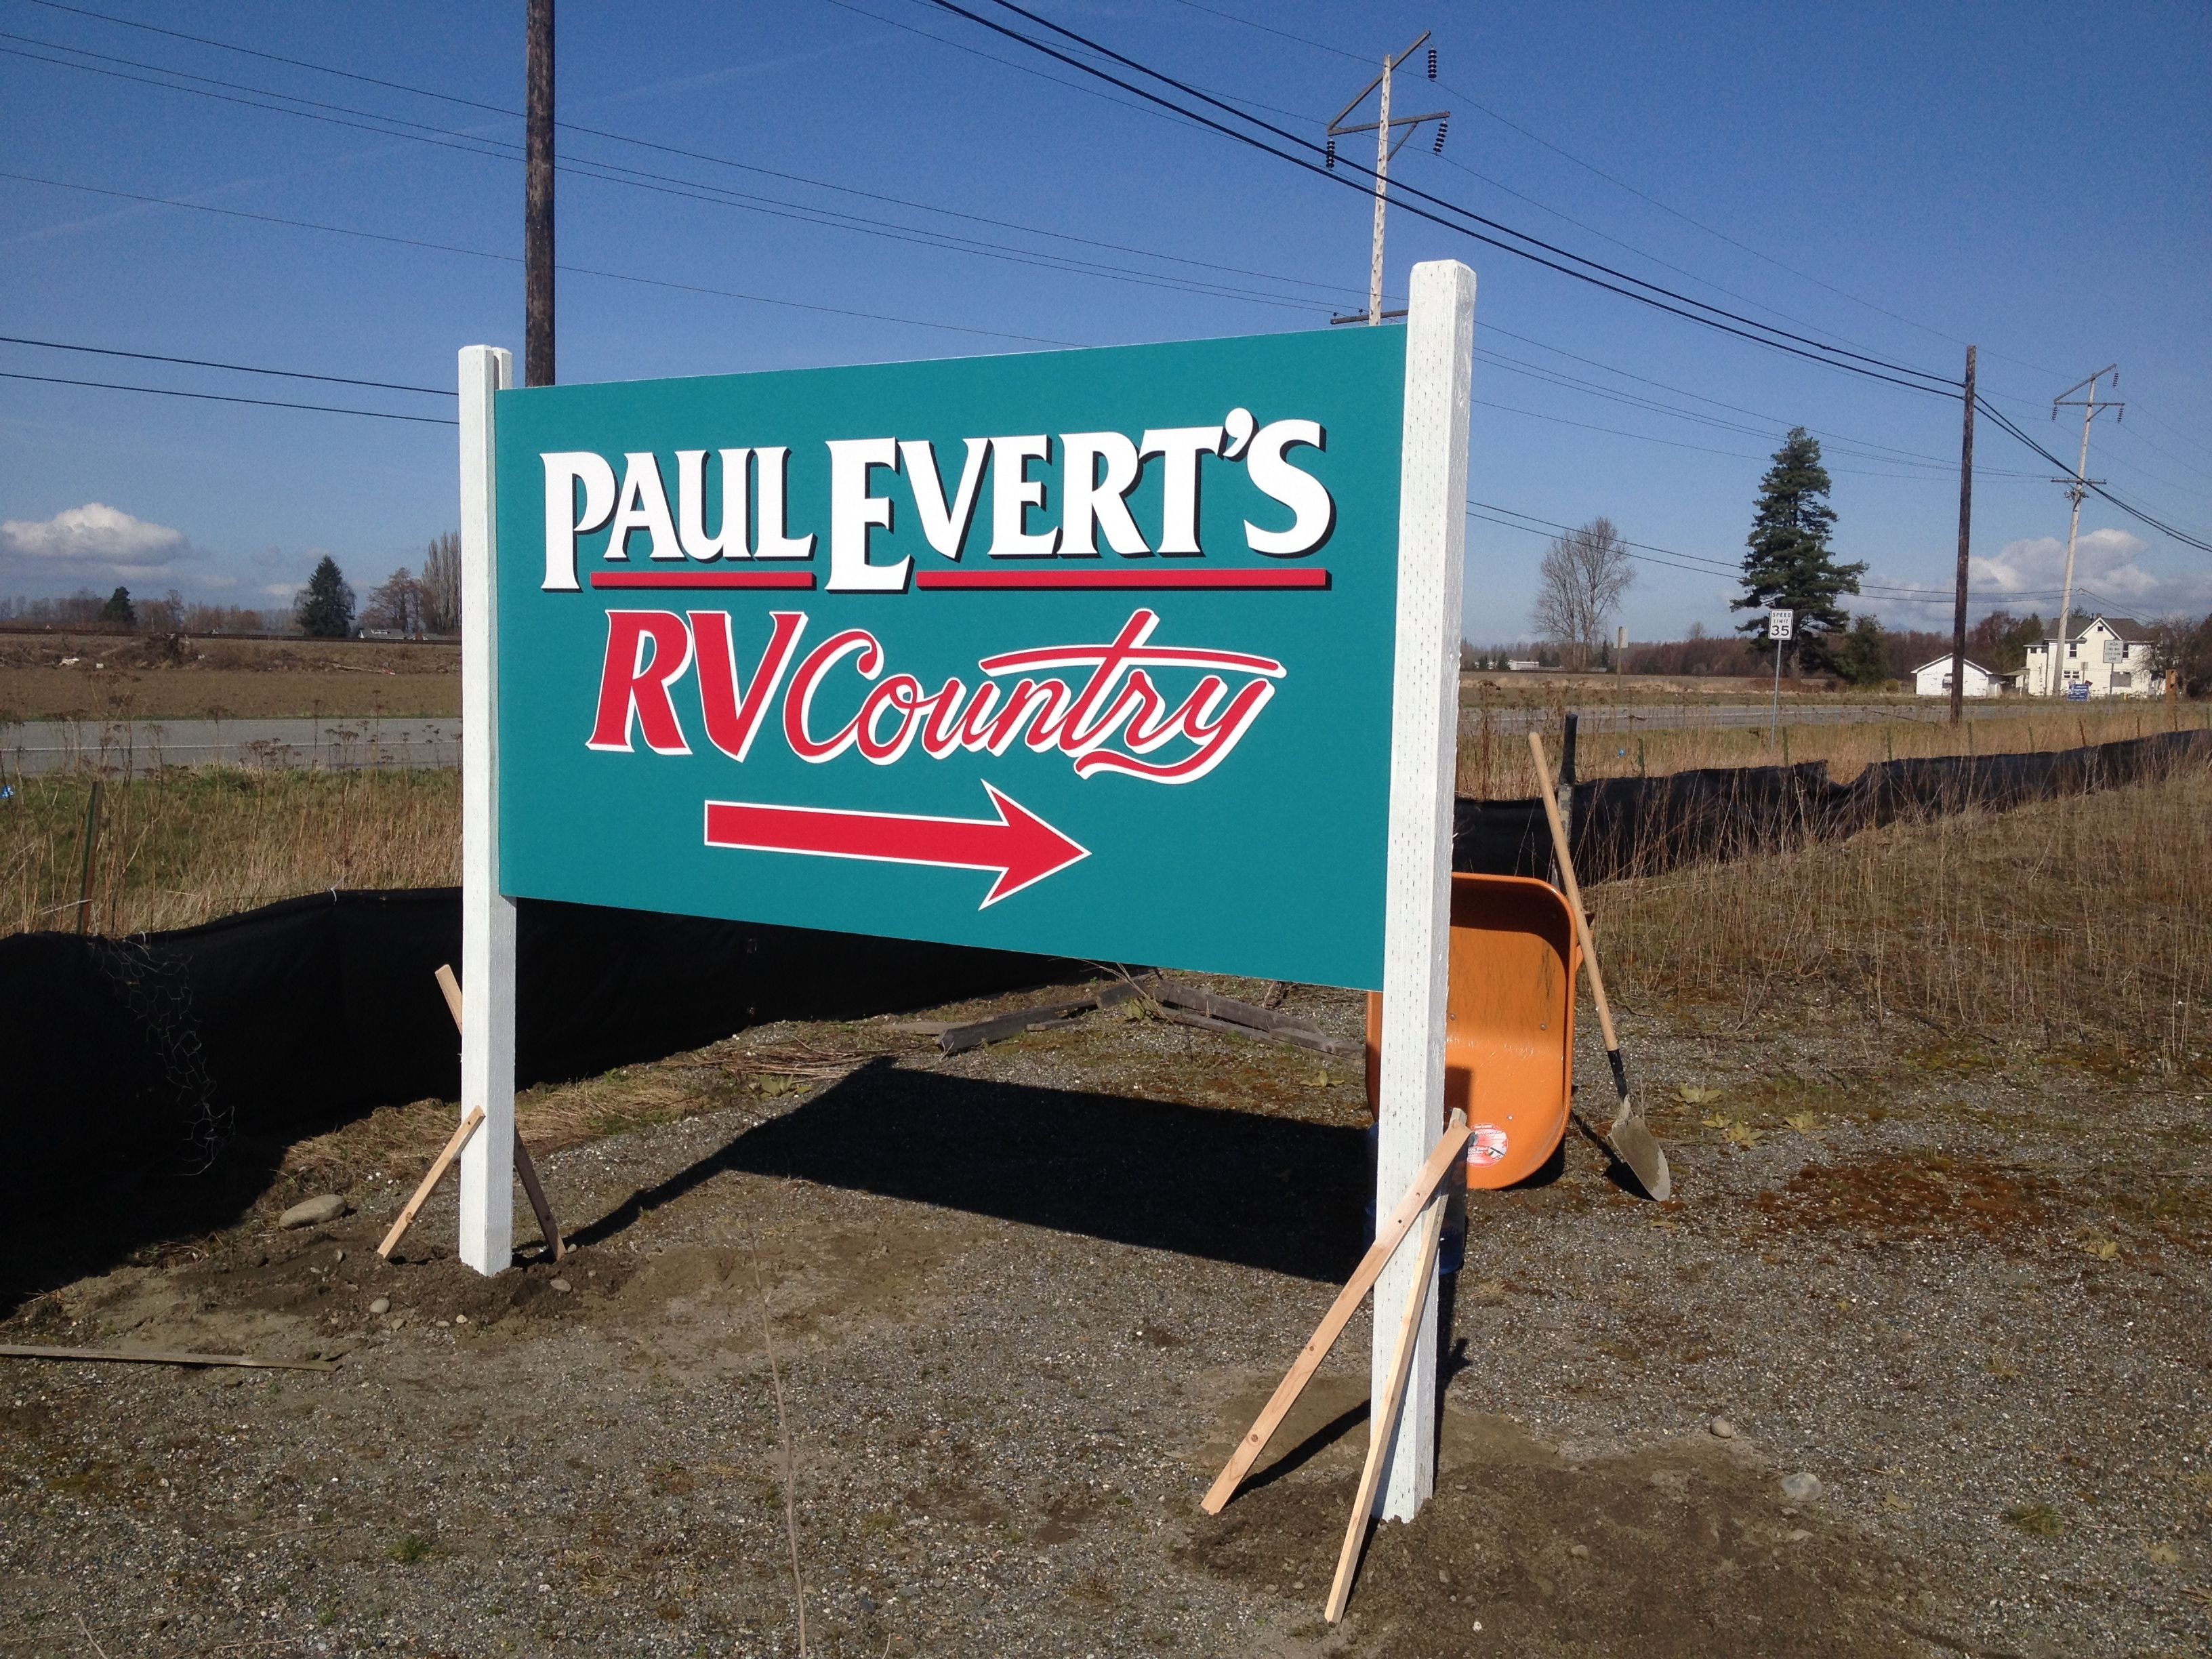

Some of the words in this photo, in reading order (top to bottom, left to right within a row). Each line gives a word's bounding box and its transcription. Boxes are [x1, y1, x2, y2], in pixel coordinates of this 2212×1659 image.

[540, 446, 816, 592] PAUL
[825, 408, 1335, 592] EVERT'S
[586, 609, 808, 763] RV
[782, 607, 1288, 785] Country
[1771, 625, 1790, 636] 35
